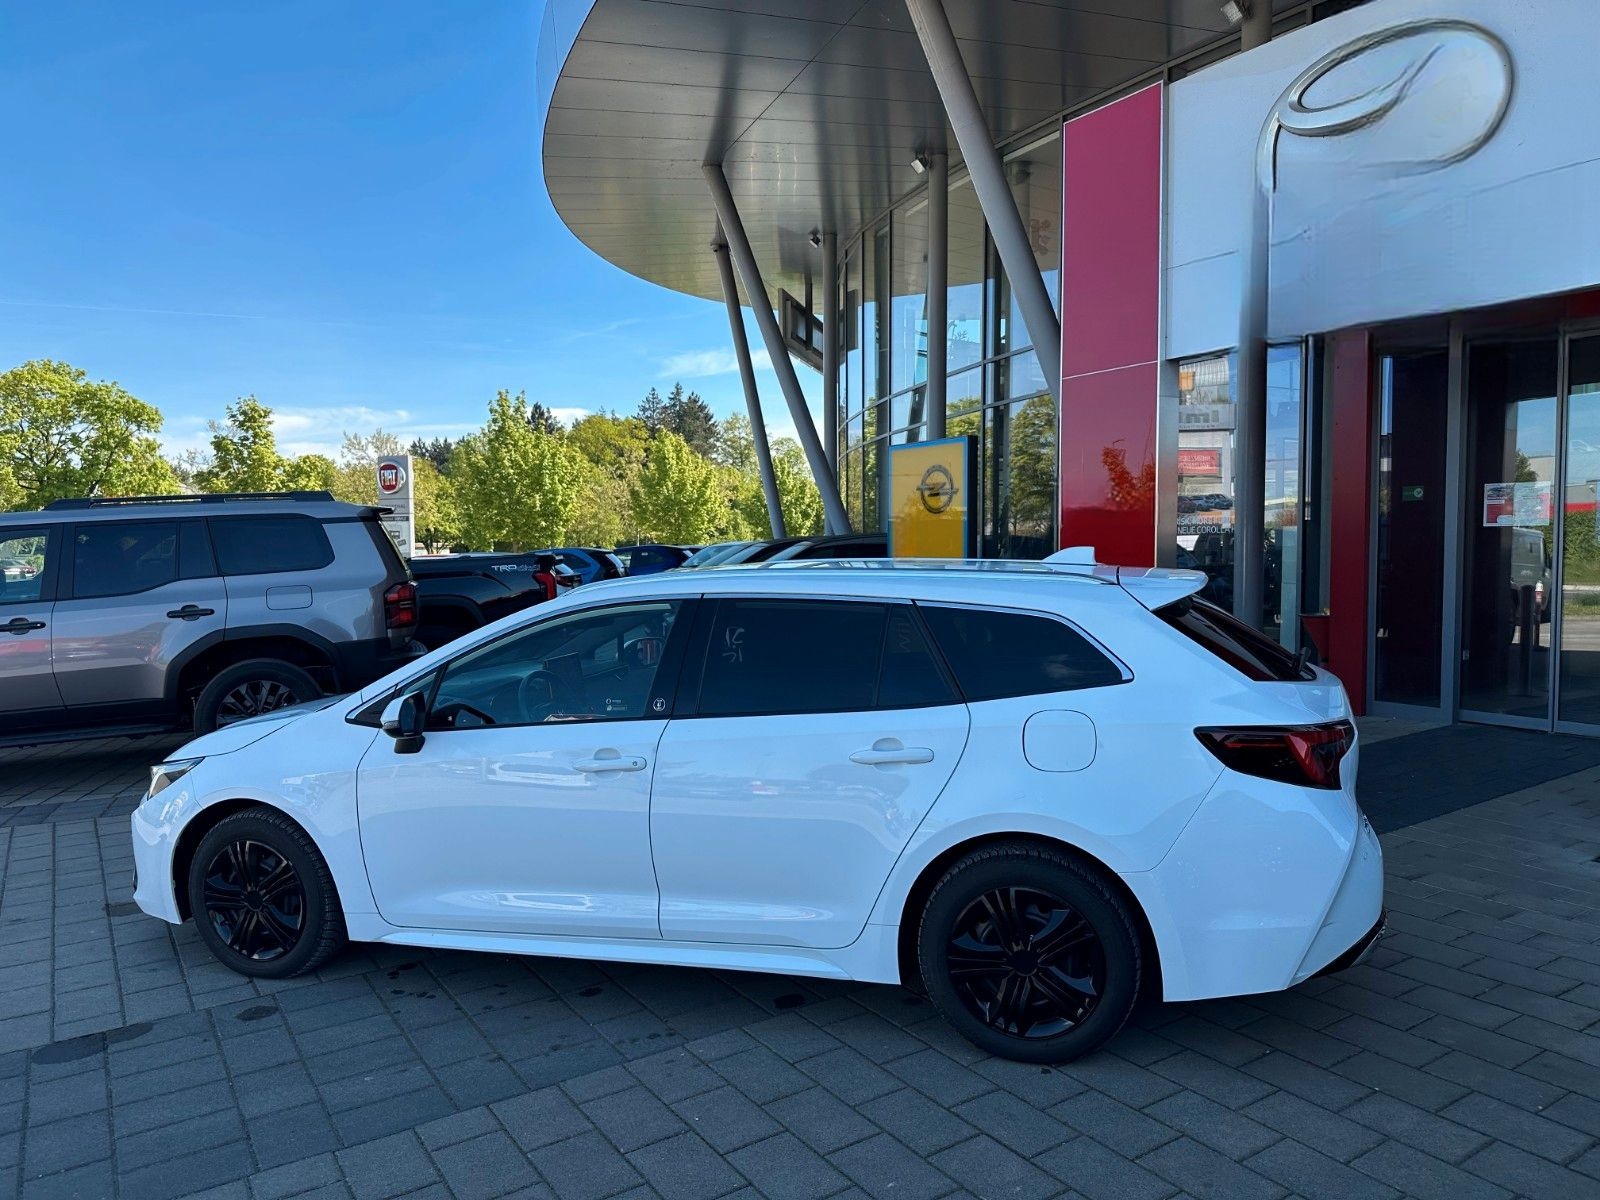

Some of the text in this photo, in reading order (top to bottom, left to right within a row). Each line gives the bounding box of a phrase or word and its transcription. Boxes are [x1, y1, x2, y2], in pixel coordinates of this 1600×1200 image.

[380, 469, 397, 486] FIAT
[1177, 525, 1231, 535] NEUE COROLLA
[491, 564, 517, 573] TRD
